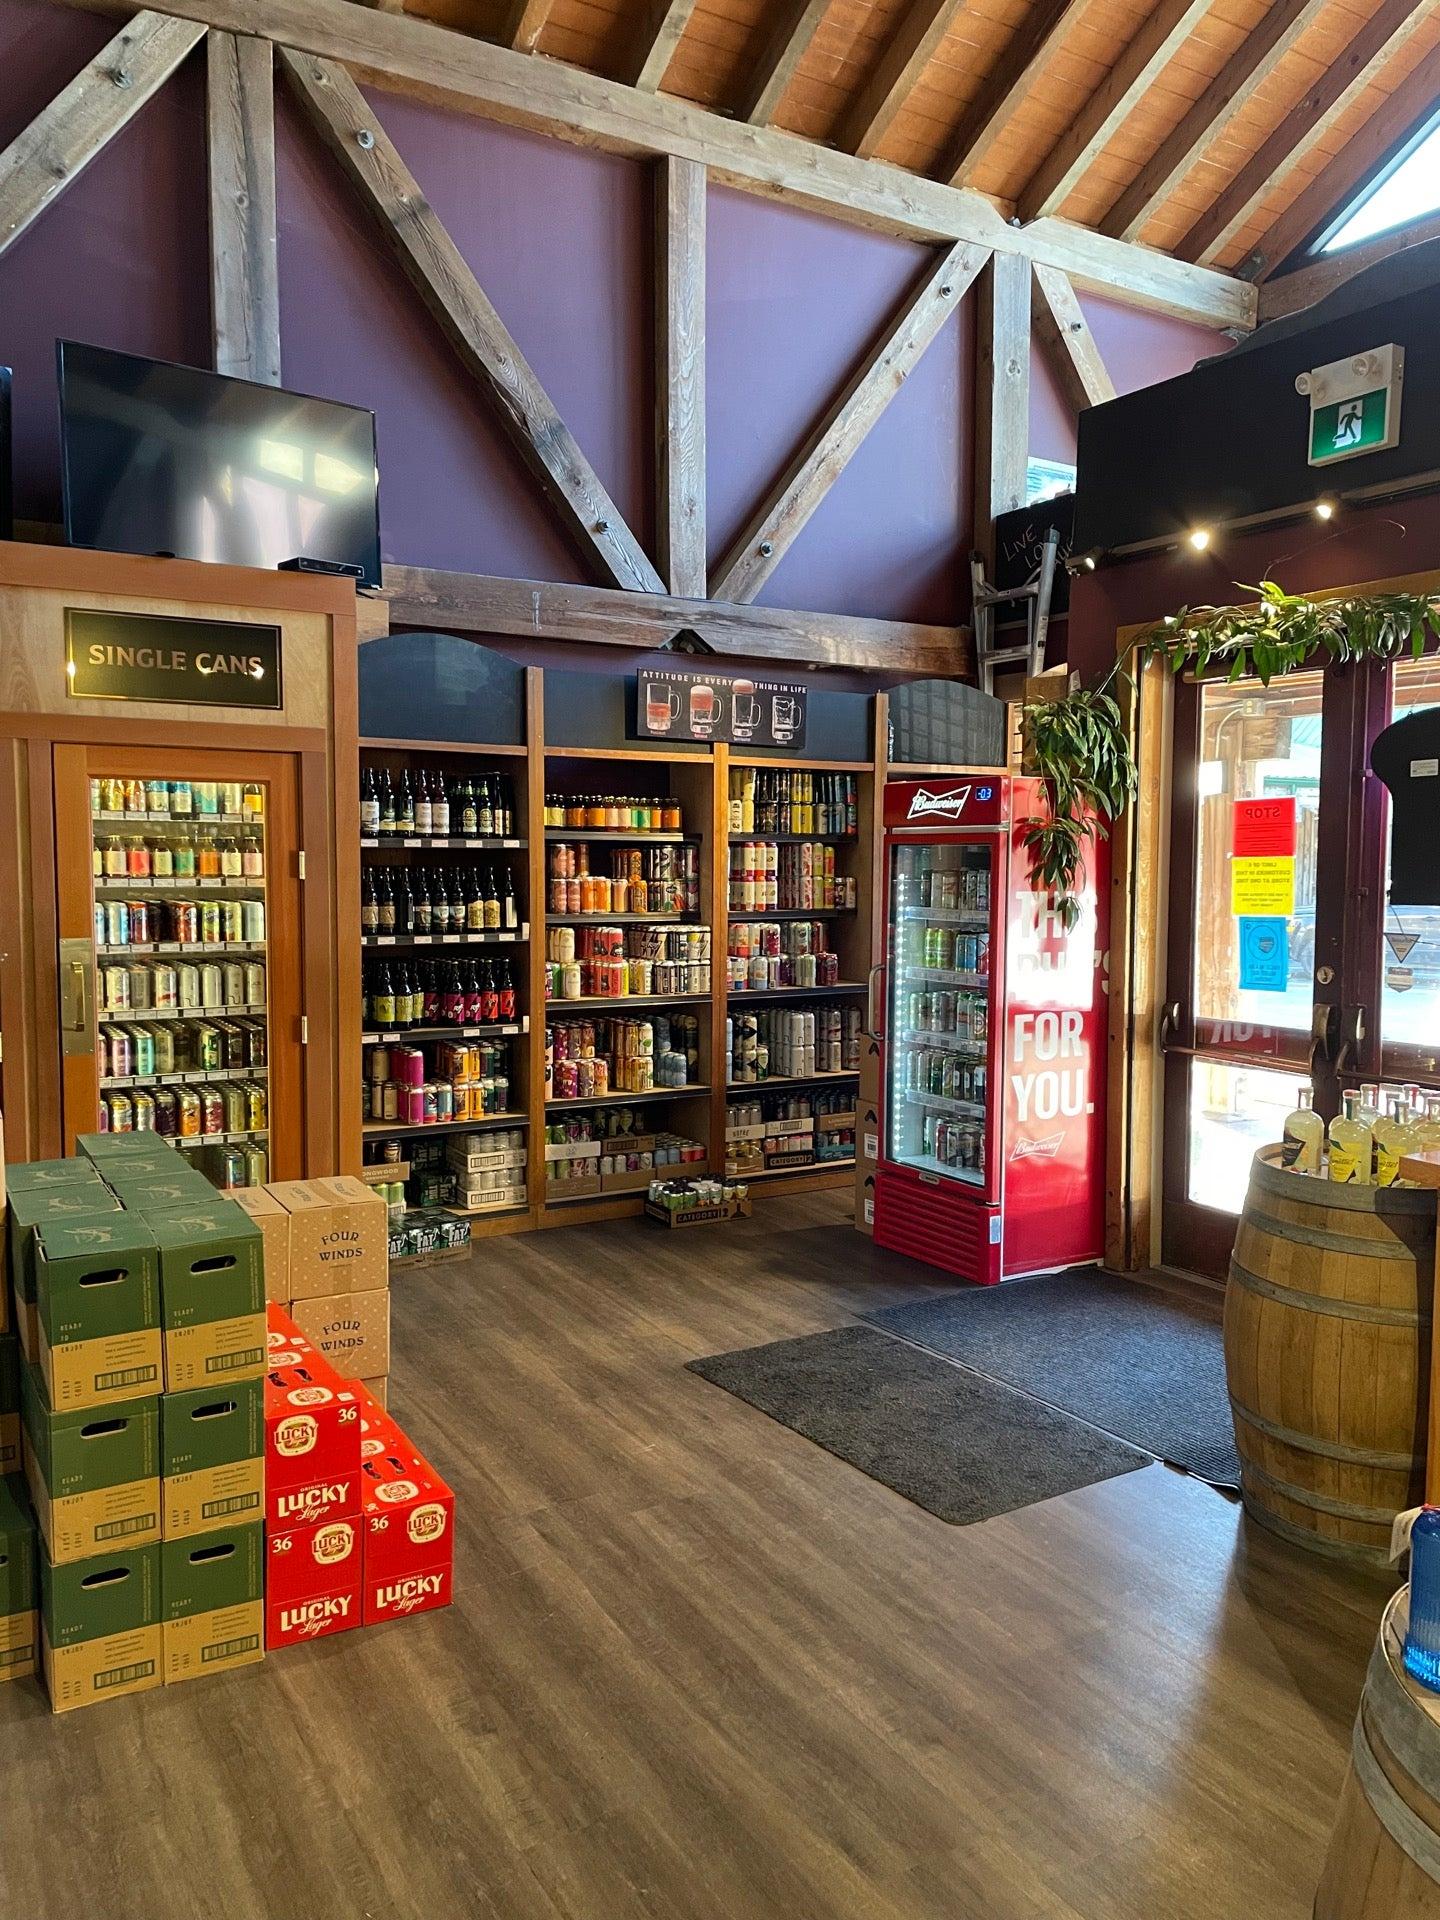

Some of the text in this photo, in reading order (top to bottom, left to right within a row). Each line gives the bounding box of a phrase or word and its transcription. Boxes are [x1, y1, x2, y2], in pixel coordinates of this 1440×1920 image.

[1003, 524, 1036, 561] LIVE
[89, 645, 264, 678] SINGLE CANS
[642, 671, 689, 682] ATTITUDE
[705, 678, 733, 687] EVERY
[754, 682, 778, 691] THING
[791, 686, 807, 694] LIFE
[912, 795, 964, 811] Budweiser
[1013, 1011, 1084, 1063] FOR
[1011, 1068, 1095, 1122] YOU.
[677, 1209, 718, 1221] CATEGORY
[321, 1231, 359, 1245] FOUR
[417, 1232, 434, 1247] FAT
[449, 1226, 465, 1241] FAT
[319, 1248, 363, 1261] WINDS
[388, 1240, 402, 1254] AT
[60, 1323, 82, 1331] READY
[323, 1321, 360, 1335] FOUR
[321, 1337, 364, 1351] WINDS
[338, 1406, 357, 1423] 36
[274, 1424, 319, 1445] LUCKY
[278, 1482, 350, 1518] LUCKY
[296, 1505, 331, 1523] Lager
[407, 1511, 448, 1534] LUCKY
[370, 1515, 389, 1532] 36
[272, 1535, 293, 1553] 36
[312, 1530, 355, 1554] LUCKY
[376, 1573, 444, 1609] LUCKY
[281, 1594, 352, 1632] LUCKY
[393, 1596, 425, 1613] Lager
[62, 1624, 83, 1634] READY
[298, 1618, 333, 1636] Lager
